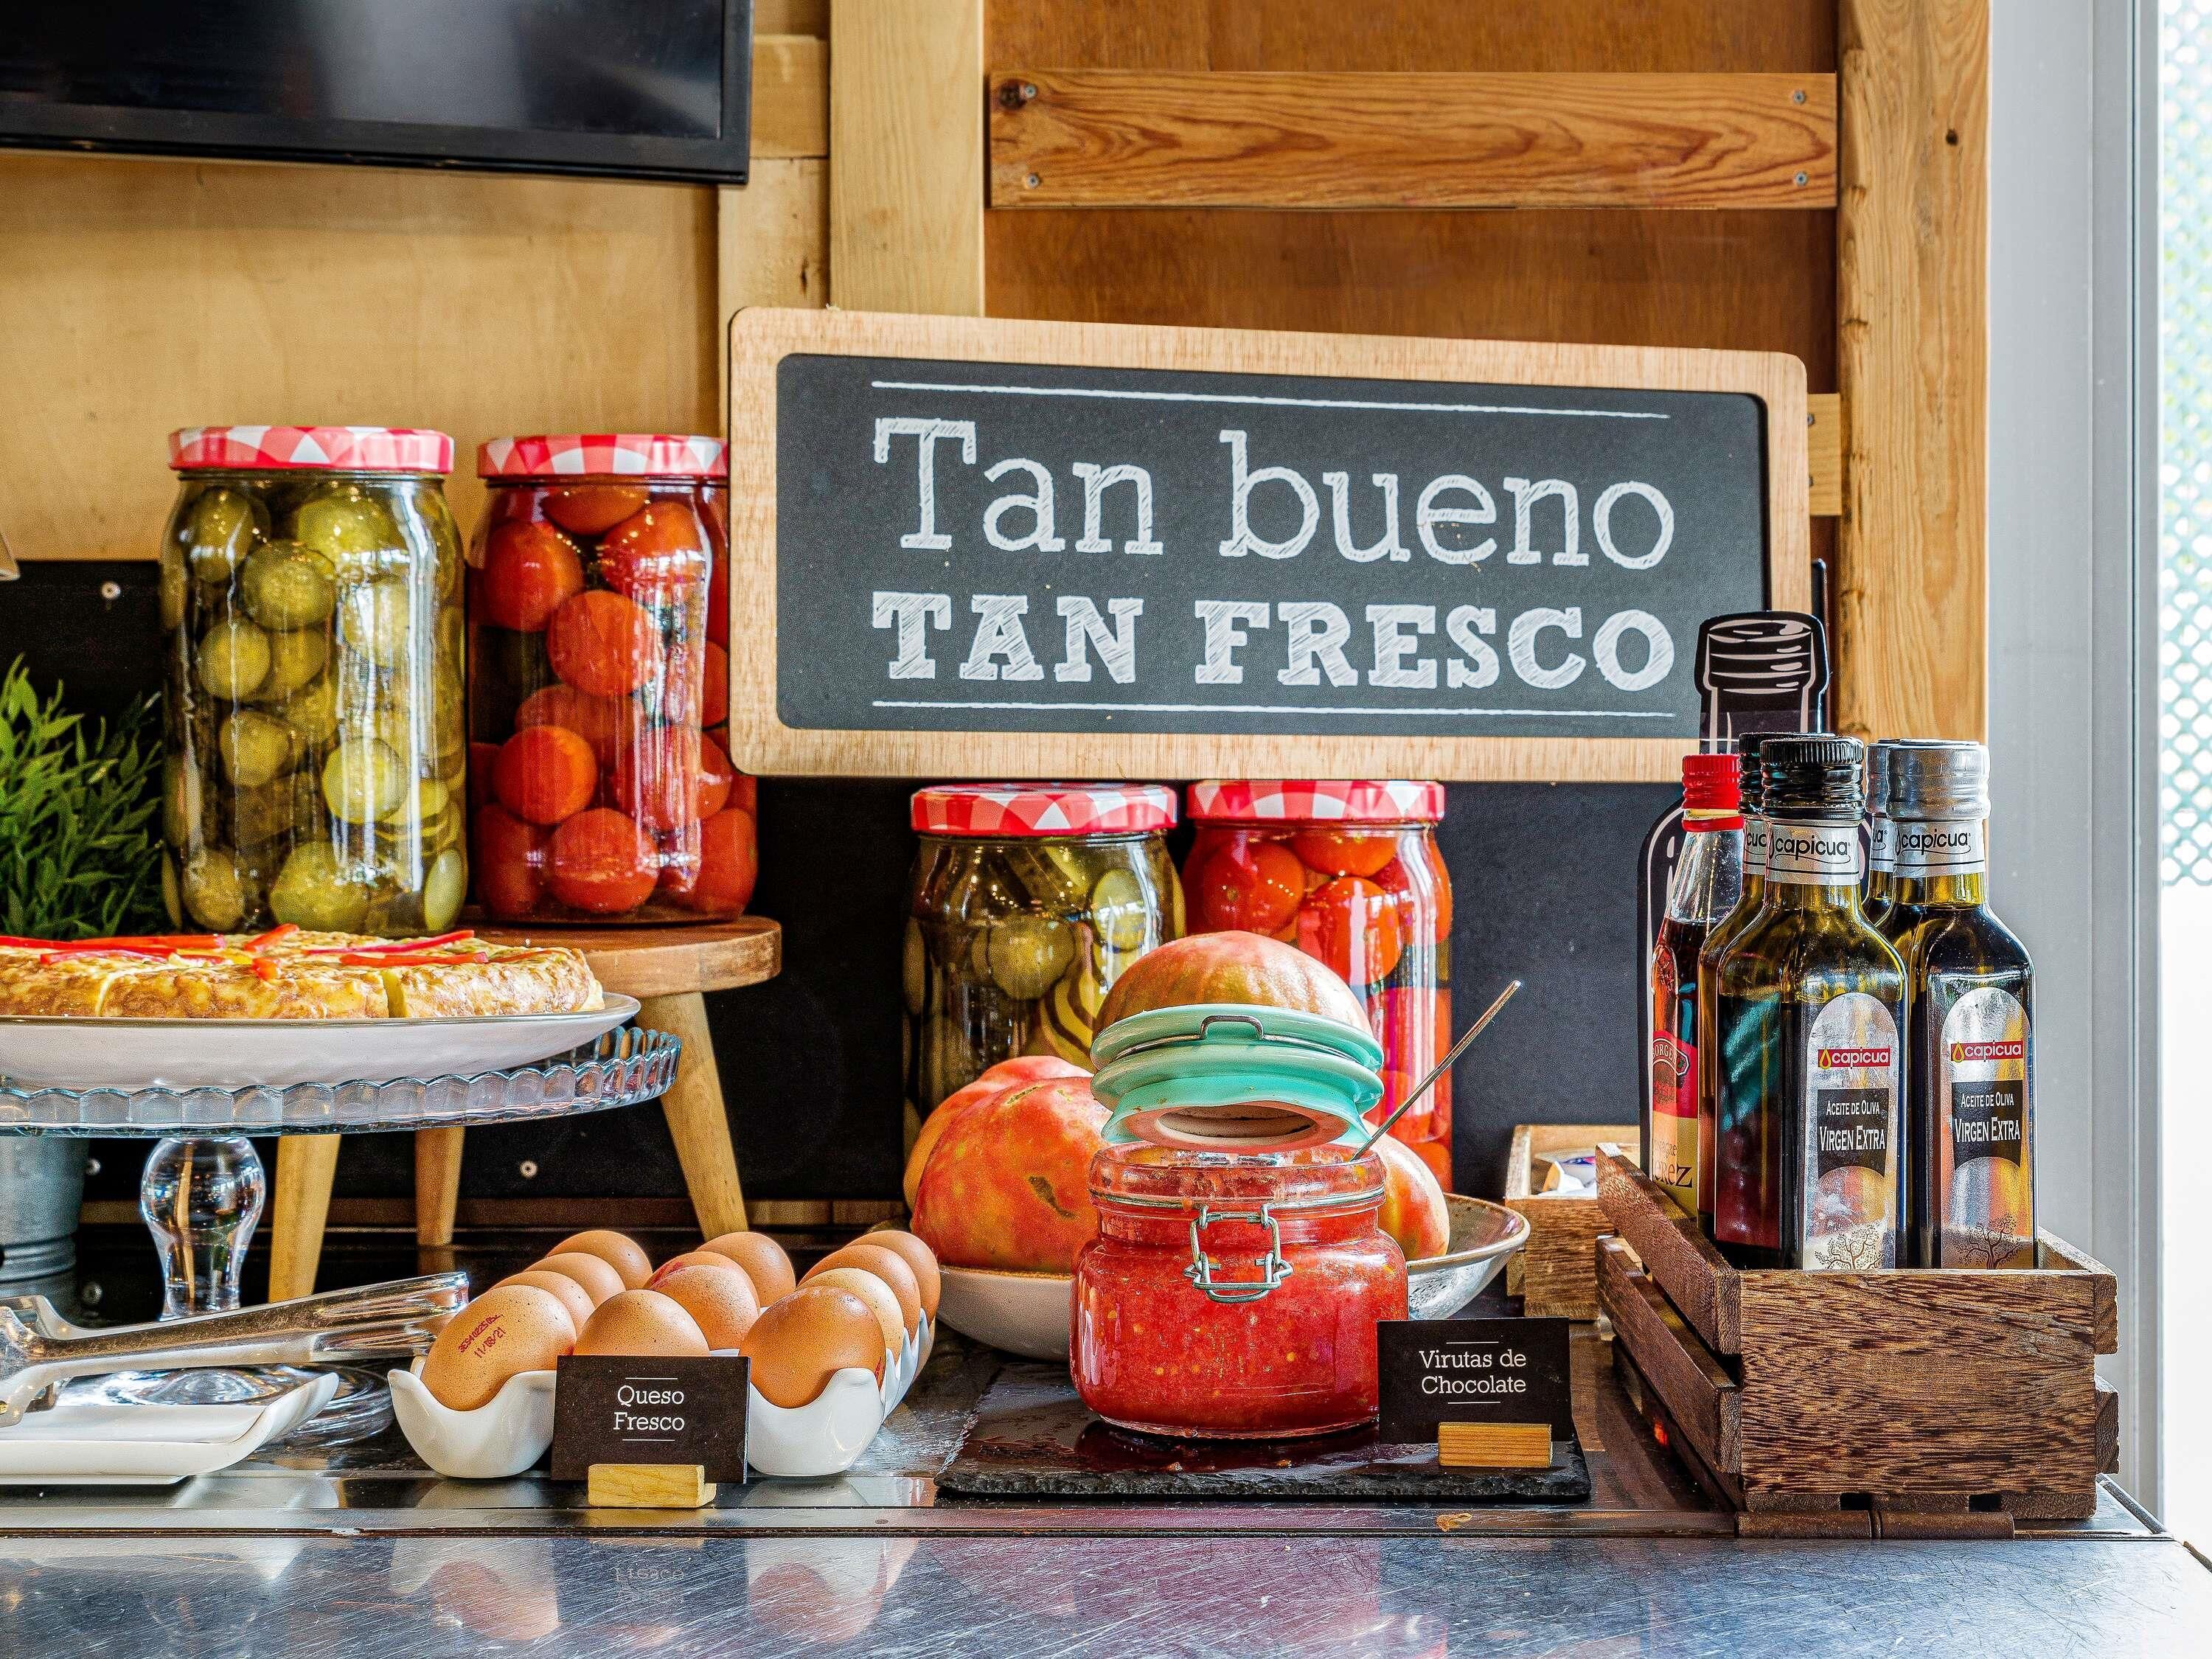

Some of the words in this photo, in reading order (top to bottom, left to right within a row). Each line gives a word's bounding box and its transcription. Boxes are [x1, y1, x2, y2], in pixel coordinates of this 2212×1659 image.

[872, 417, 1164, 556] Tan
[1218, 429, 1674, 570] bueno
[872, 591, 1145, 684] TAN
[1194, 599, 1675, 692] FRESCO
[1775, 835, 1848, 860] capicua
[1902, 829, 1968, 855] capicua
[1832, 1047, 1889, 1069] capicua
[1965, 1040, 2022, 1062] capicua
[1419, 1349, 1492, 1369] Virutas
[1499, 1349, 1527, 1368] de
[1422, 1374, 1527, 1394] Chocolate
[617, 1385, 685, 1408] Queso
[613, 1411, 685, 1431] Fresco
